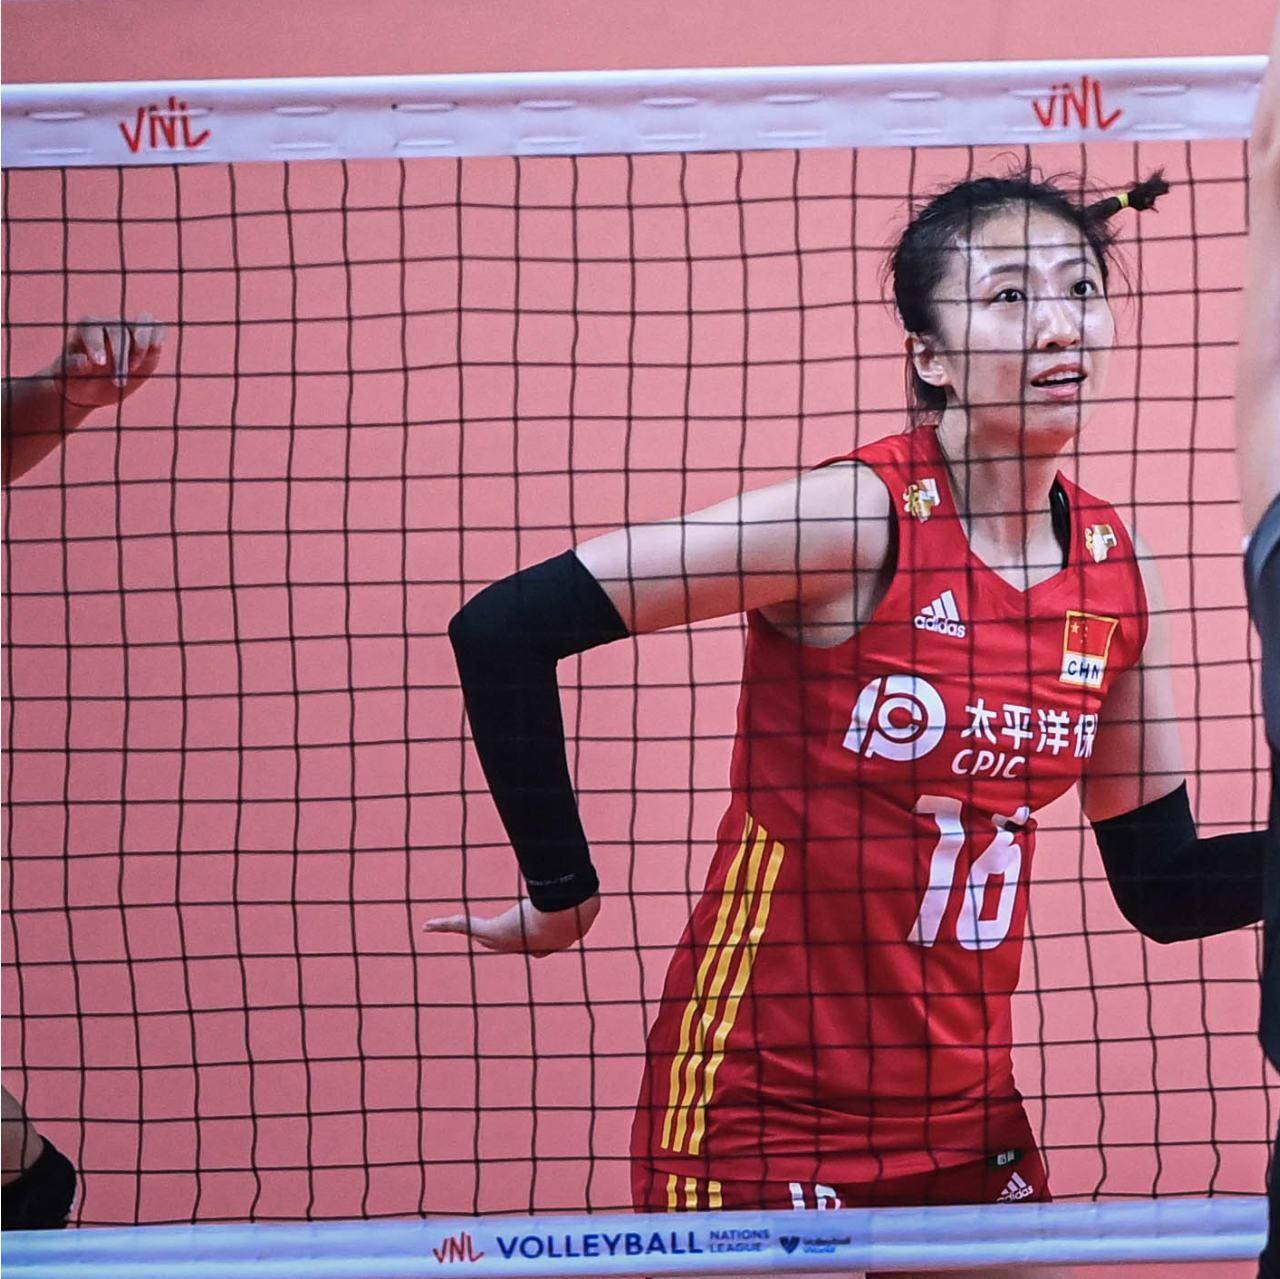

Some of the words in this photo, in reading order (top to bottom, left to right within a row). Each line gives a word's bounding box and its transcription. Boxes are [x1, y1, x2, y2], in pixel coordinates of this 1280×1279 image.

[1032, 74, 1124, 131] VNL
[119, 95, 212, 154] VNL
[914, 615, 967, 639] adidas
[1067, 660, 1100, 680] CHN
[951, 748, 1026, 779] CPIC
[432, 1231, 485, 1264] VNL
[496, 1230, 704, 1260] VOLLEYBALL
[709, 1228, 771, 1241] NATIONS
[709, 1242, 762, 1254] LEAGUE
